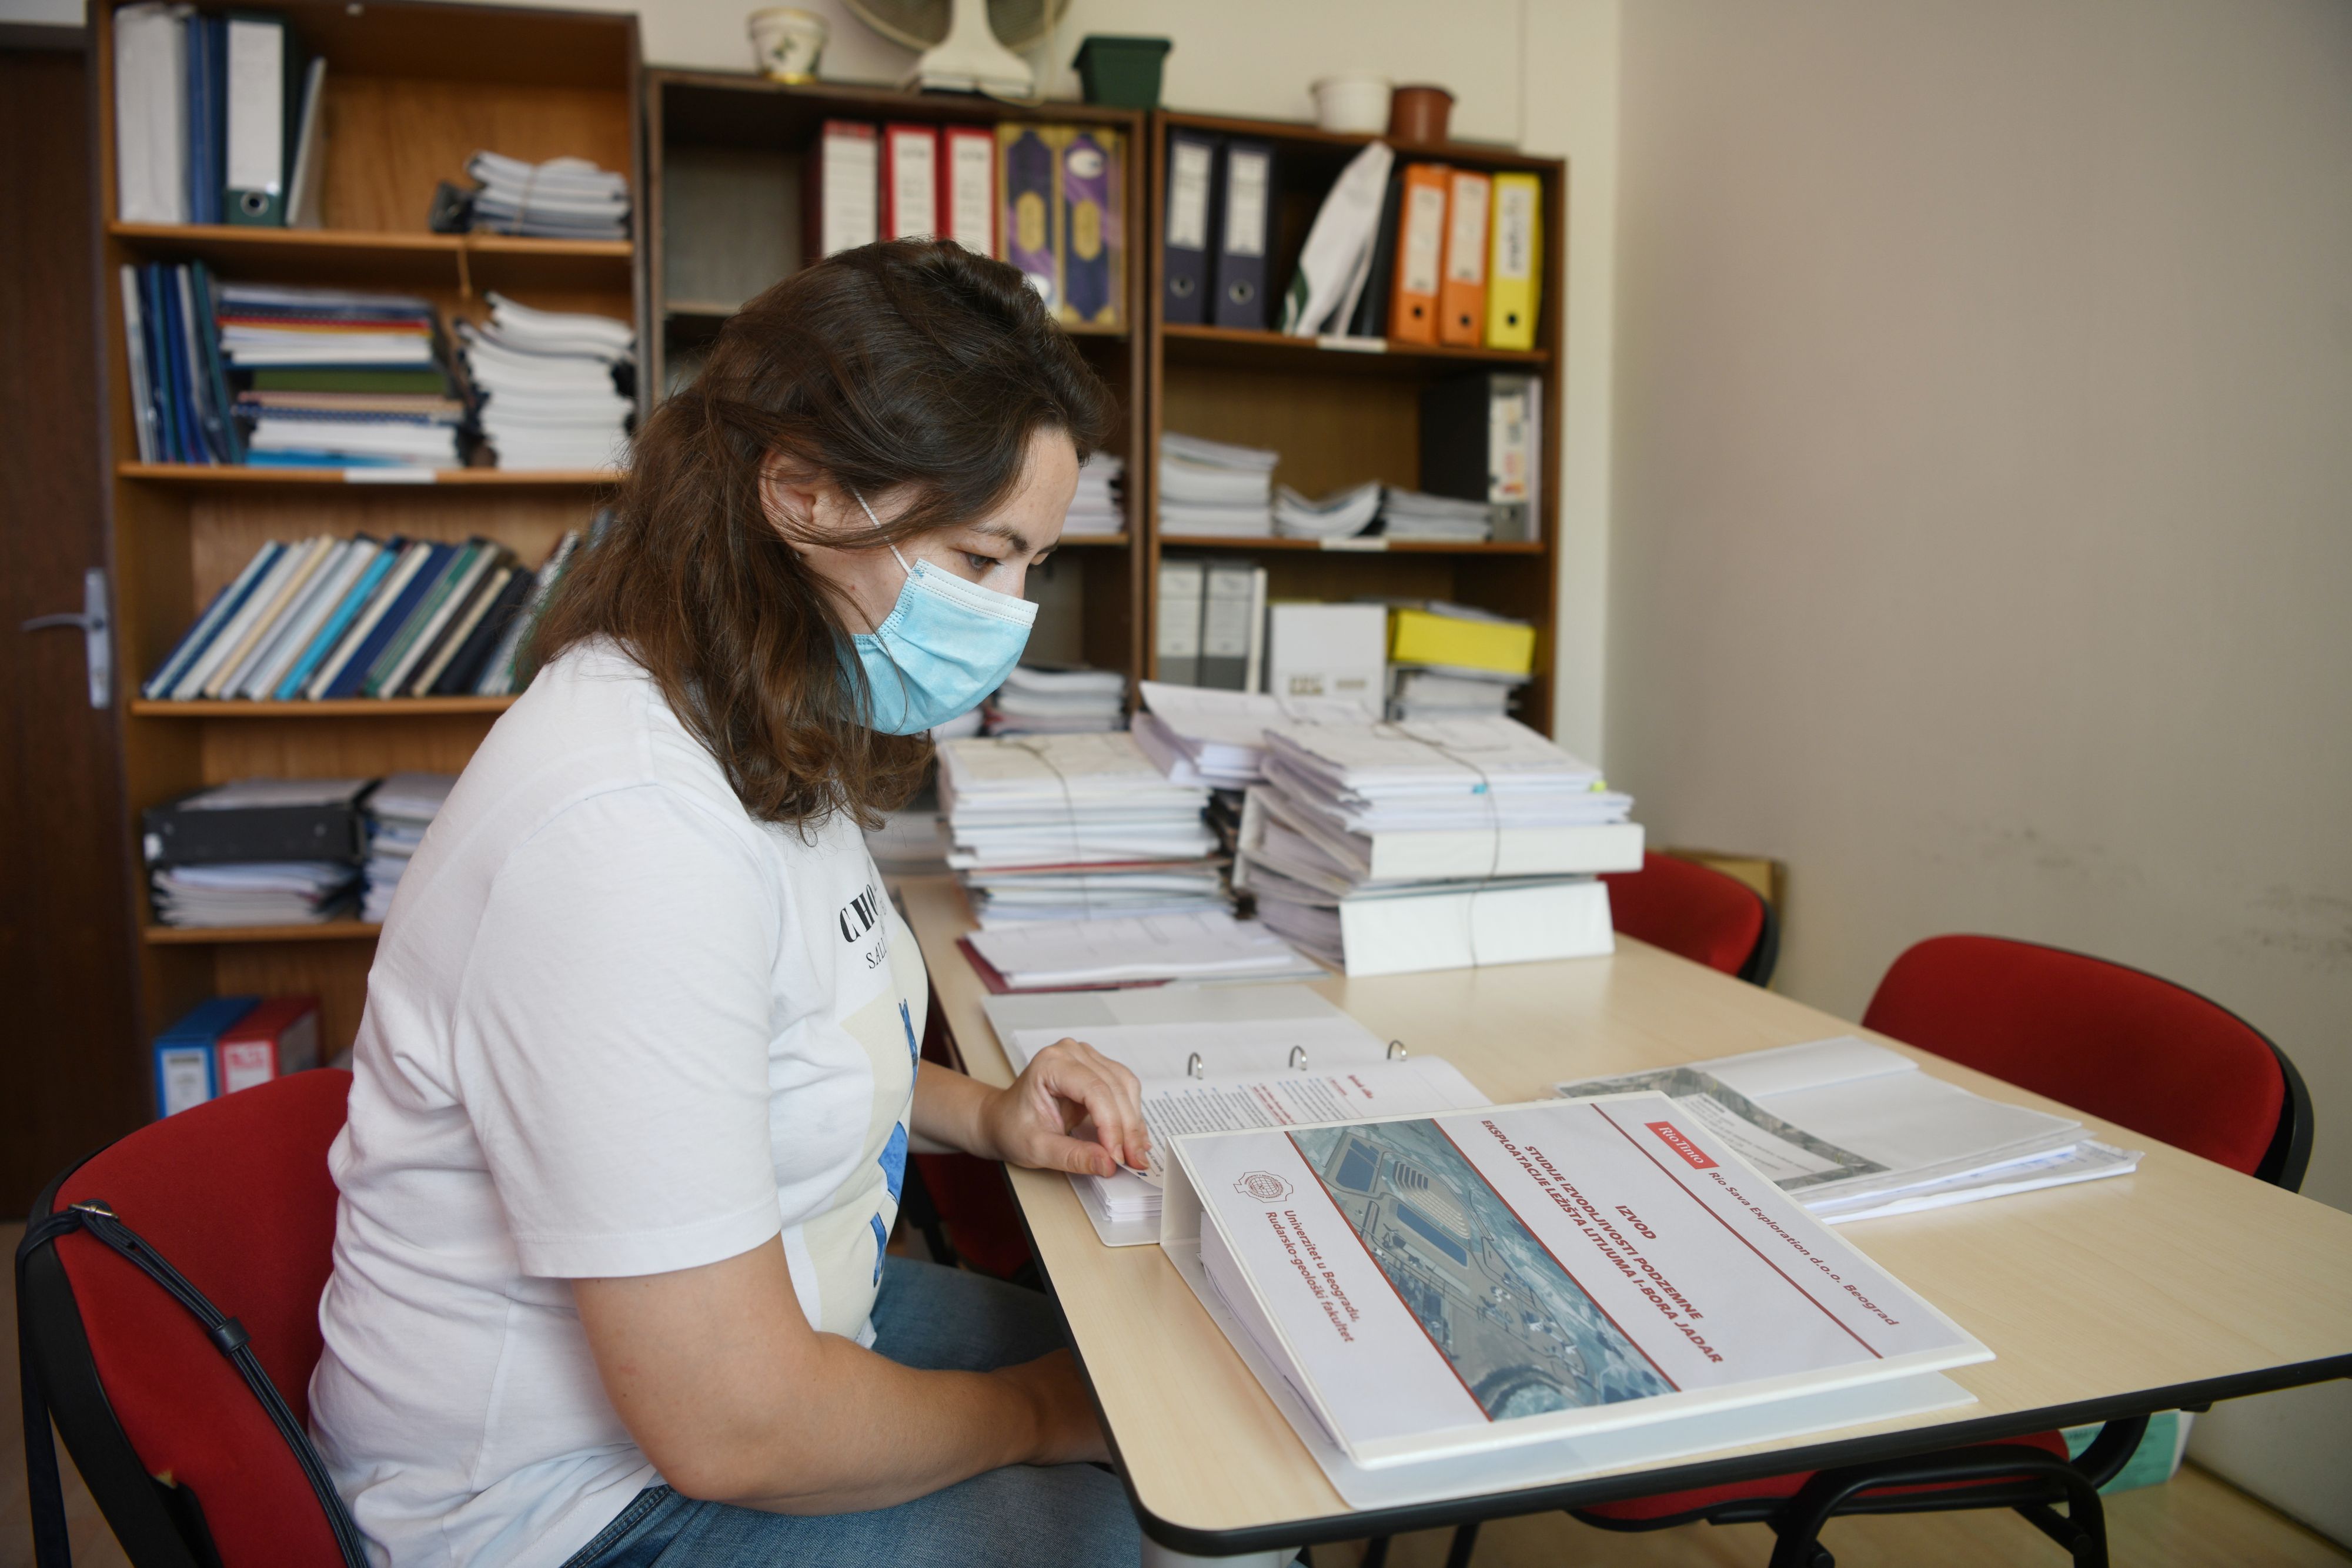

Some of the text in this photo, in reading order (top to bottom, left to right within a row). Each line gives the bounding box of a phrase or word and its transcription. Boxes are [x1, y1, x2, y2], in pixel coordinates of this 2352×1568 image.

[1659, 1126, 1703, 1164] Rio Tinto
[1265, 1211, 1355, 1343] Rudarsko-geološki fakultet
[1284, 1210, 1322, 1261] Univerzitet
[1322, 1271, 1361, 1322] Beogradu,
[1481, 1119, 1723, 1363] EKSPLOATACIJE LEŽIŠTA LITIJUMA I-BORA JADAR
[1525, 1146, 1704, 1320] STUDIJE IZVODLJIVOSTI PODZEMNE
[1615, 1205, 1656, 1239] IZVOD
[1709, 1172, 1900, 1326] Rio Sava Exploration d.o.o. Beograd
